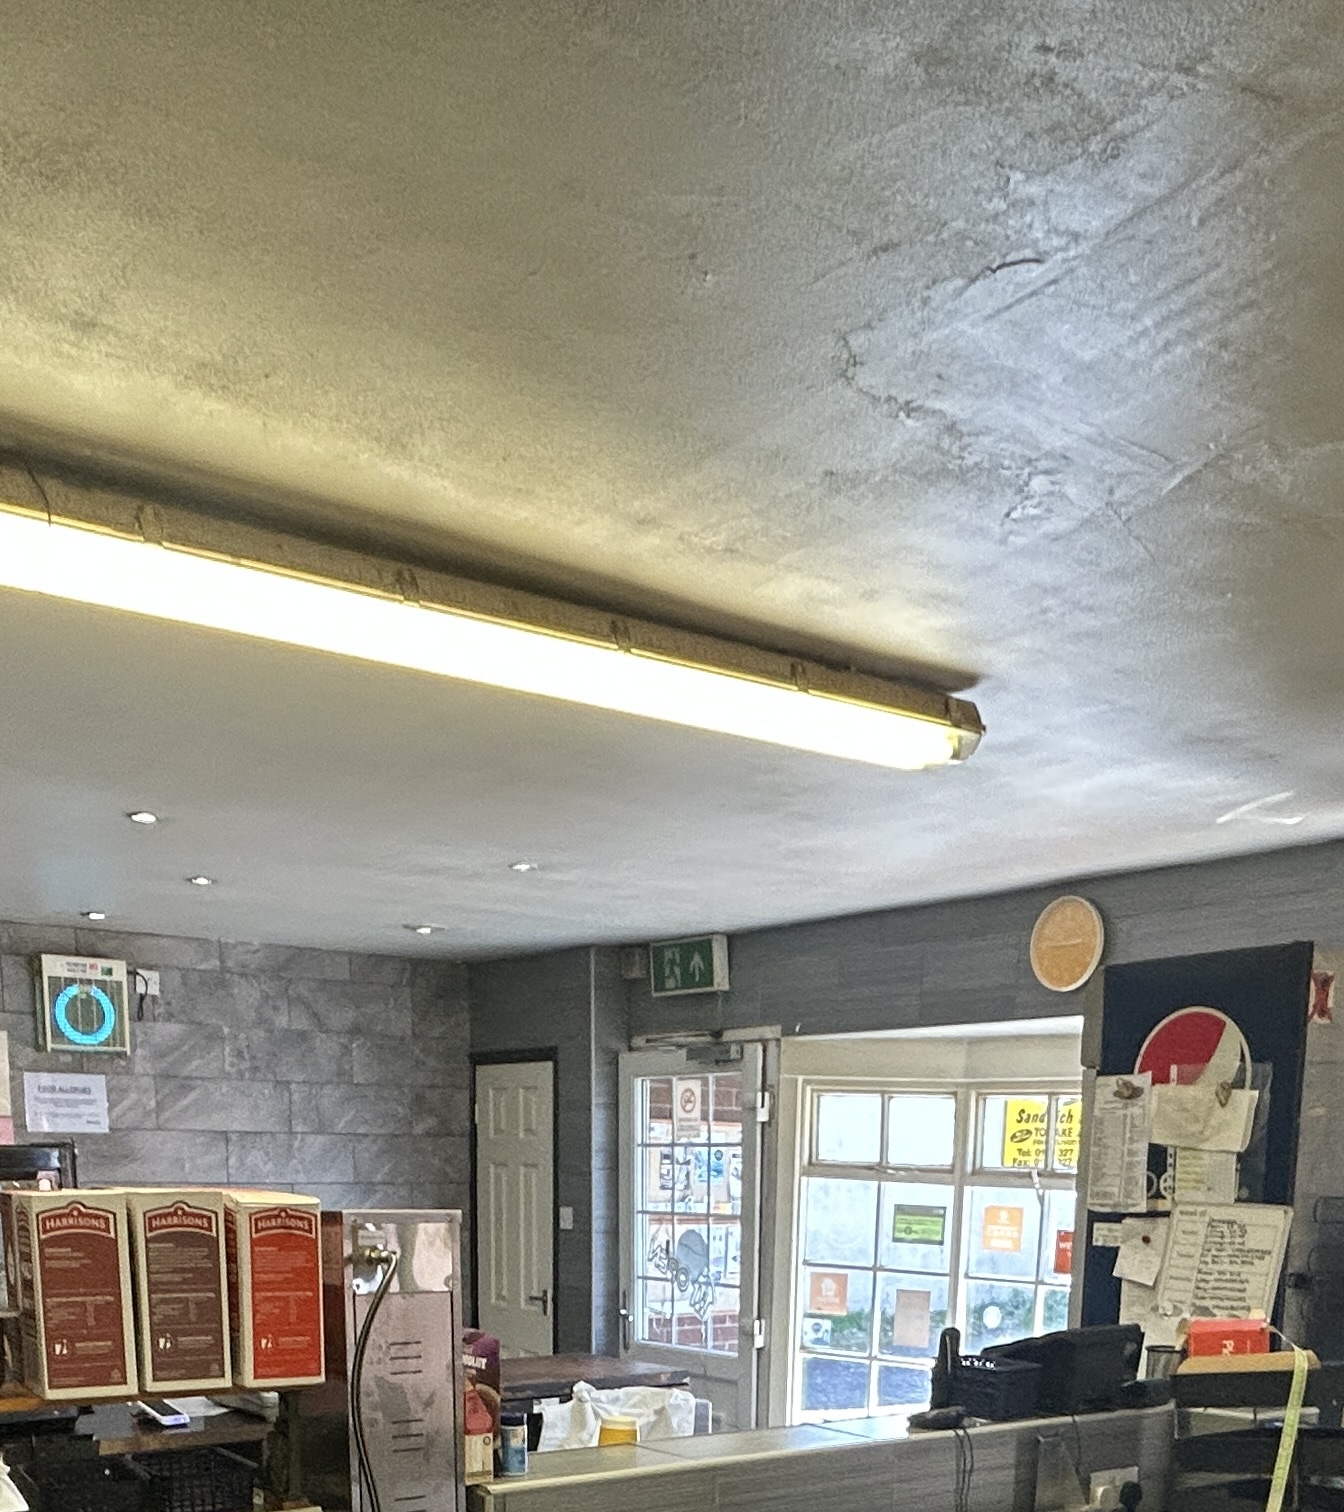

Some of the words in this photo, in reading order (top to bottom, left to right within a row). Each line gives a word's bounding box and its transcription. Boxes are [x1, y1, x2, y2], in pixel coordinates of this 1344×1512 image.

[1016, 1108, 1073, 1124] Sandich
[45, 1215, 106, 1230] HARRISONS
[151, 1214, 209, 1228] HARRISONS
[257, 1217, 309, 1230] HARRISONS
